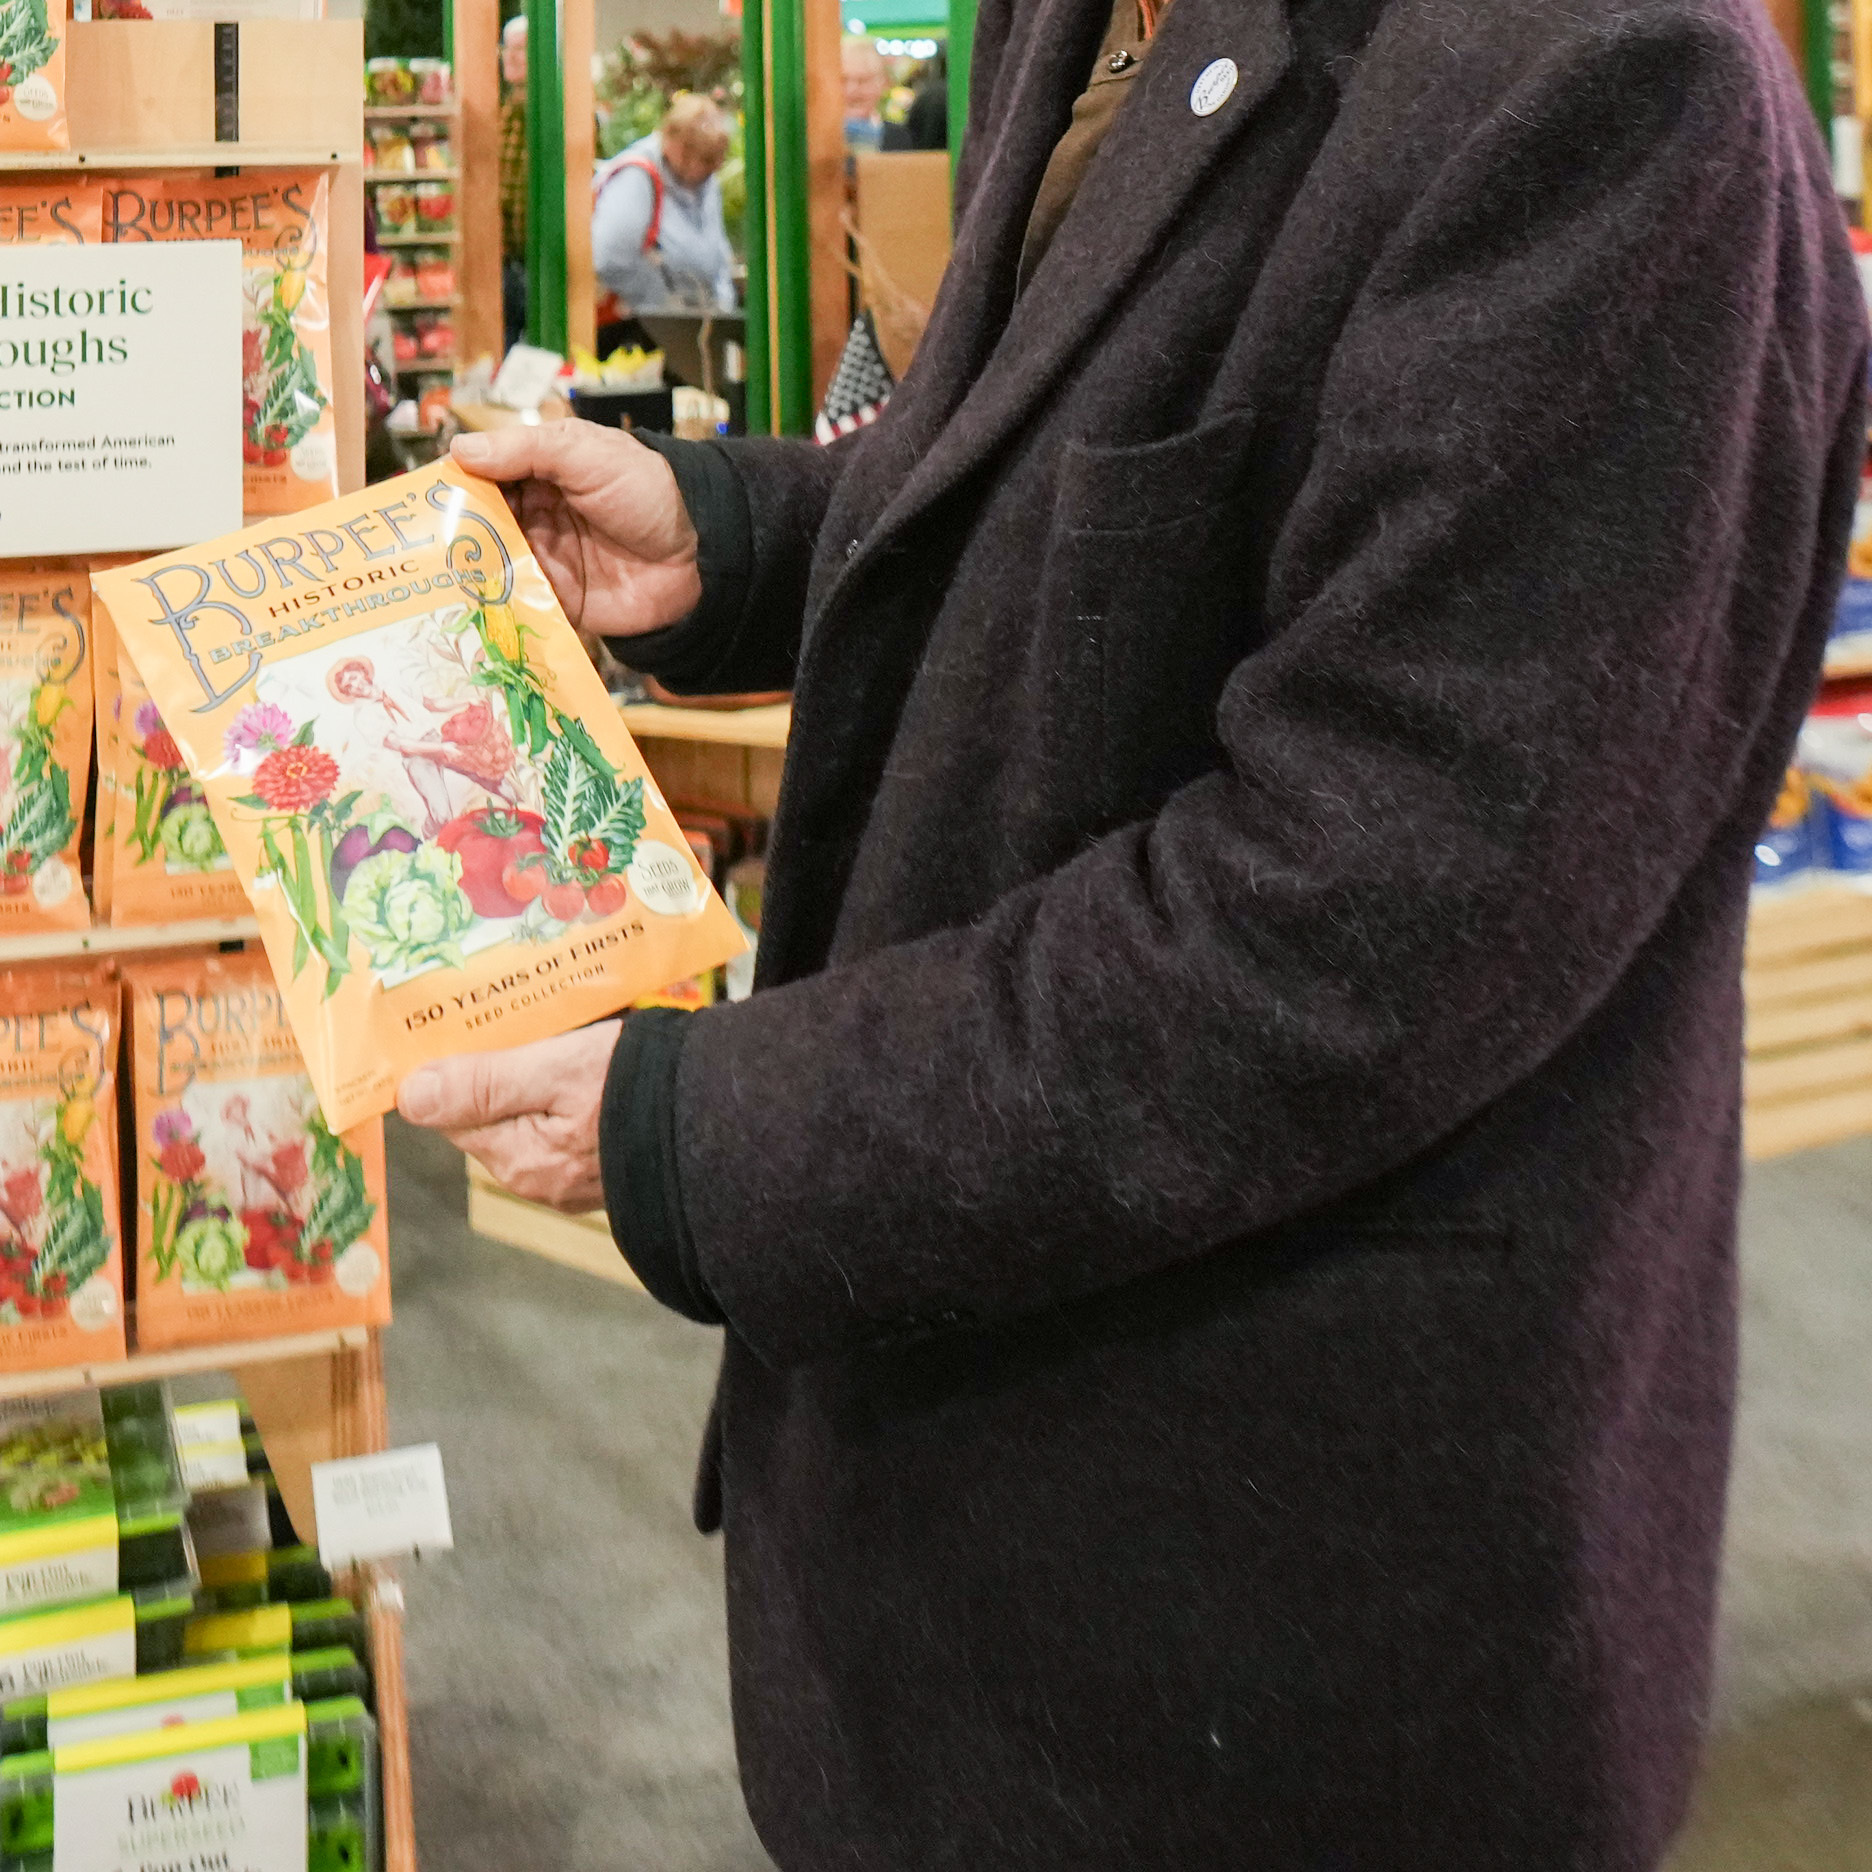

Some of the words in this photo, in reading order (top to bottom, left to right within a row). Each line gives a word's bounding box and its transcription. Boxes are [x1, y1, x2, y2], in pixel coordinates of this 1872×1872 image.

[104, 183, 316, 270] BURPEE'S
[27, 458, 54, 474] the
[58, 458, 87, 472] test
[91, 456, 110, 471] of
[113, 455, 153, 470] time.
[100, 433, 175, 449] American
[131, 479, 514, 714] BURPEE'S
[208, 568, 486, 665] BREAKTHROUGHS
[268, 560, 420, 618] HISTORIC
[638, 859, 680, 881] SEEDS
[661, 877, 691, 897] GROW
[405, 1003, 444, 1031] 150
[452, 970, 530, 1010] YEARS
[535, 954, 565, 976] OF
[570, 919, 644, 962] FIRSTS
[465, 1006, 504, 1030] SEED
[511, 962, 606, 1012] COLLECTION
